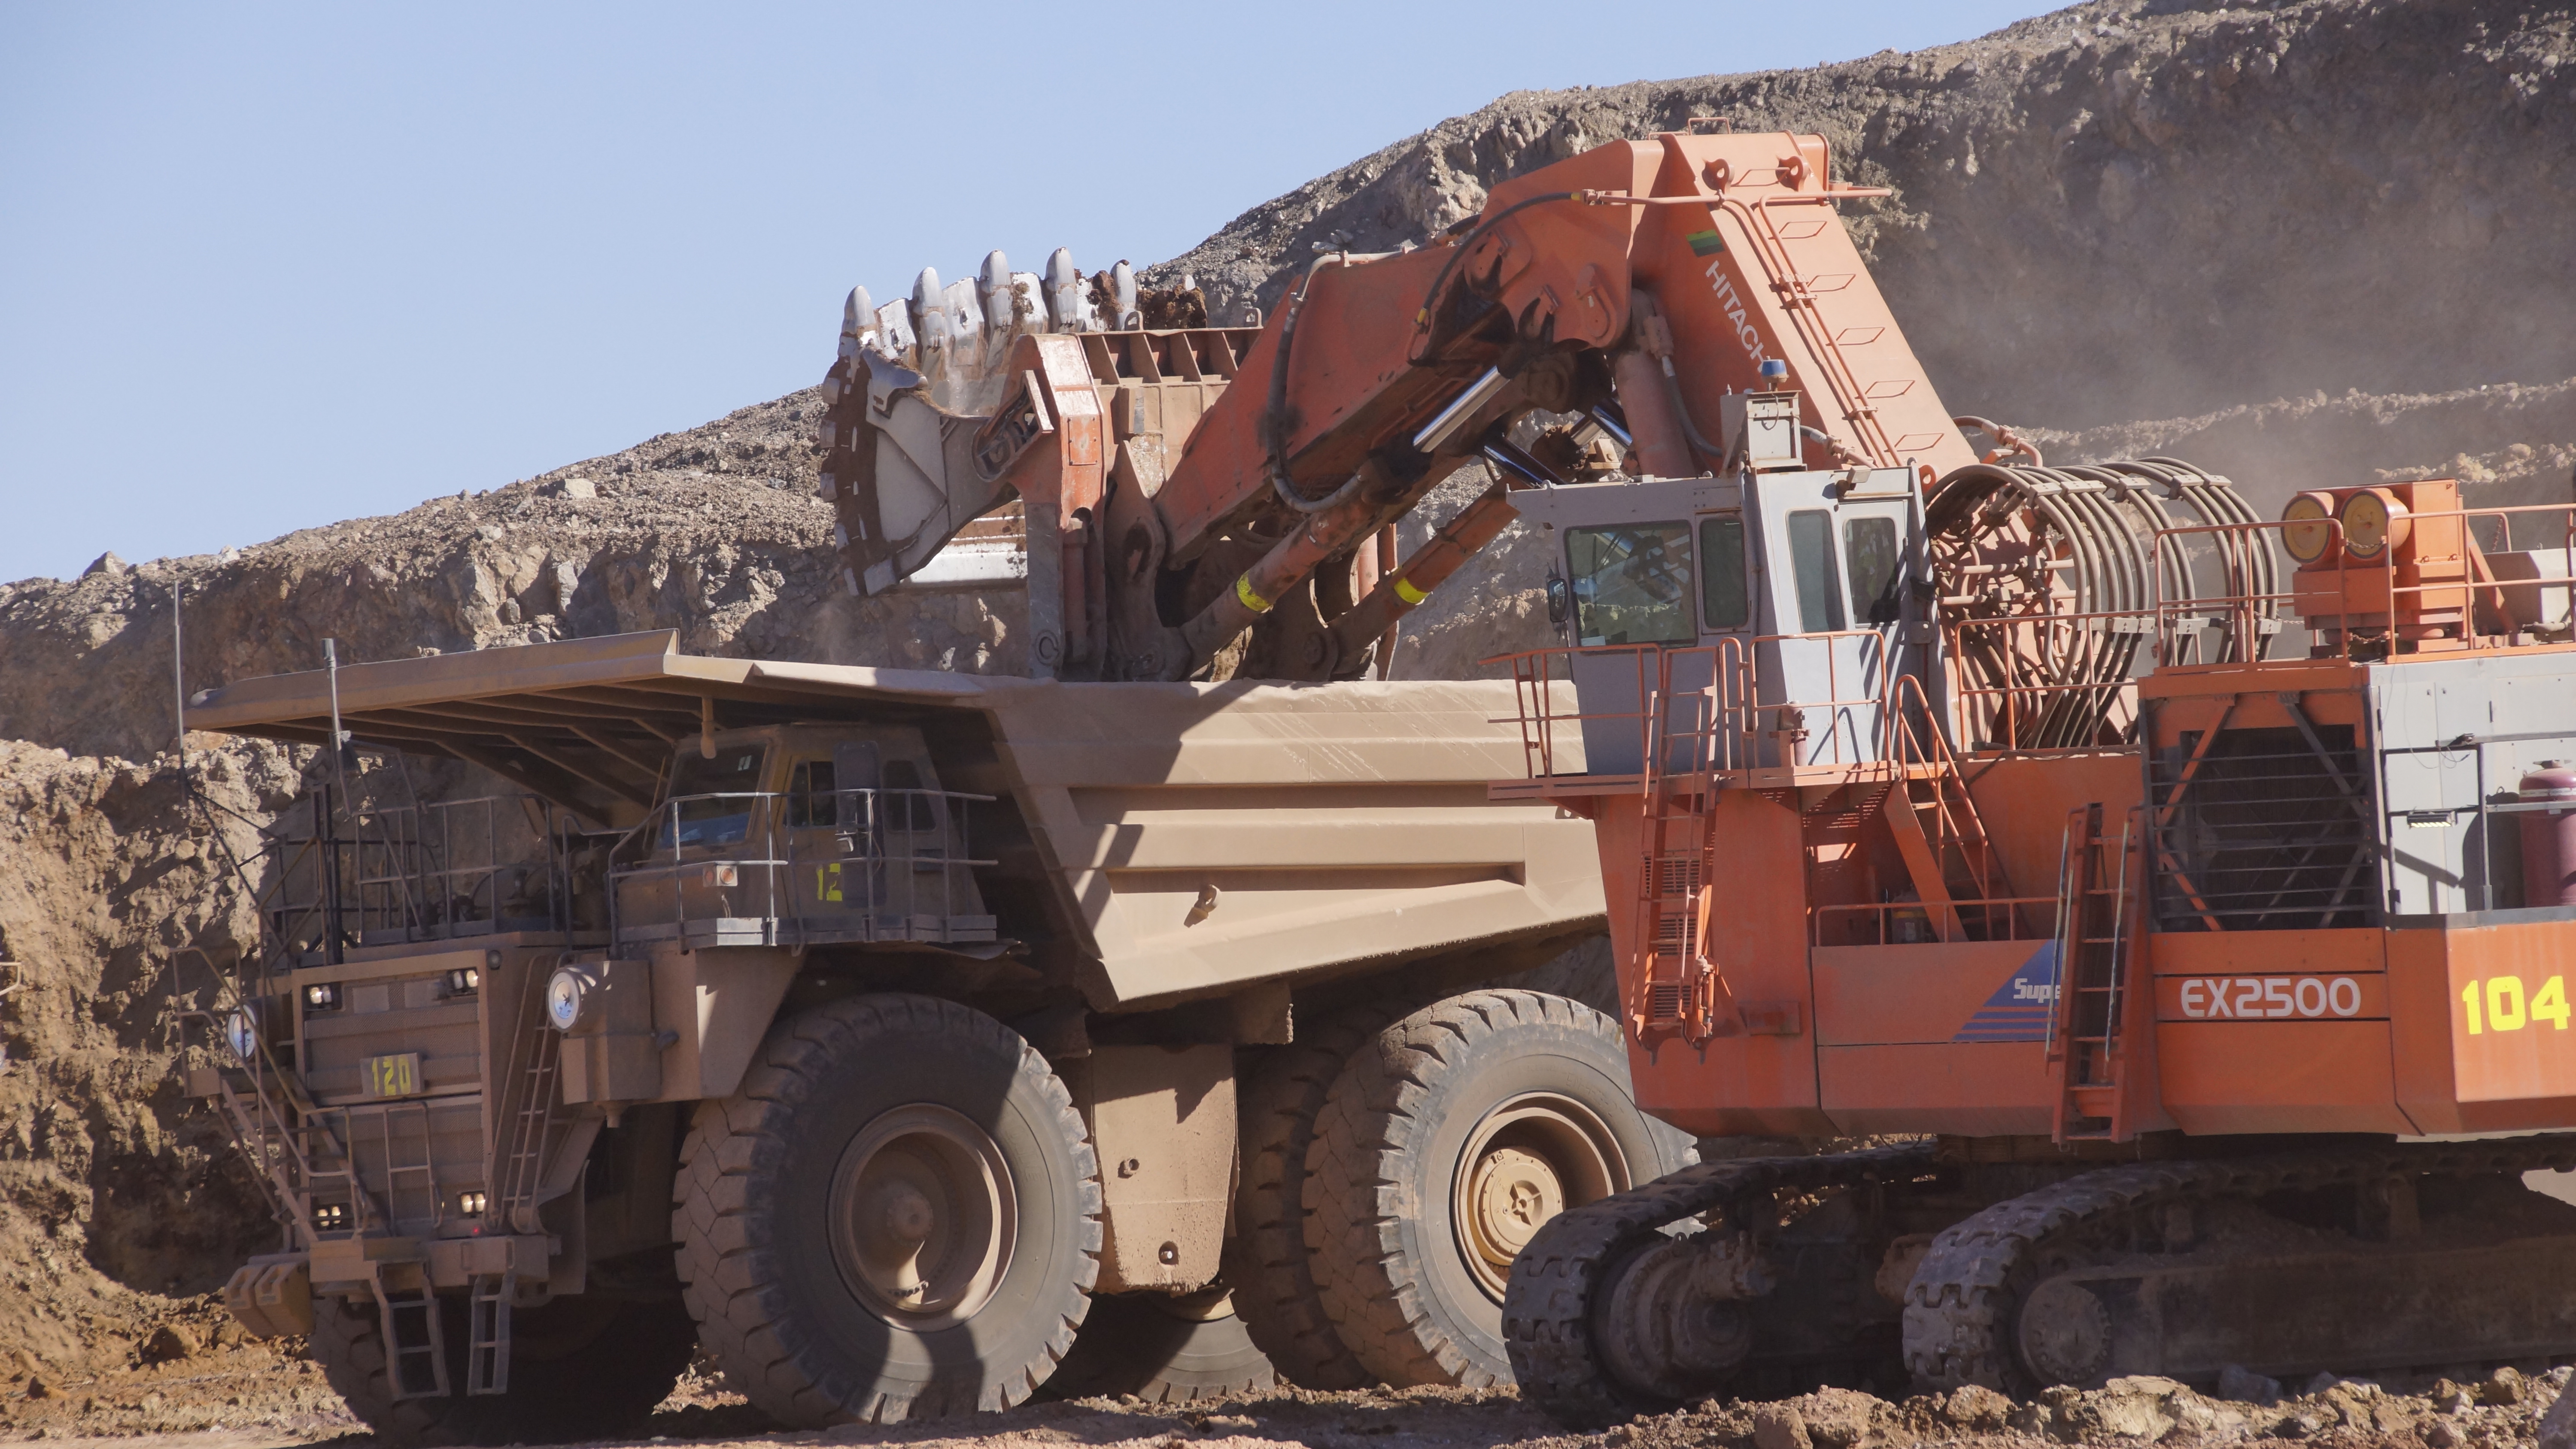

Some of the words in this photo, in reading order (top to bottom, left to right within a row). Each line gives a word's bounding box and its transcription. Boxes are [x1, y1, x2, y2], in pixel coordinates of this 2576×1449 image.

[2181, 978, 2361, 1017] EX2500
[2462, 976, 2571, 1035] 104
[371, 1055, 411, 1097] 120
